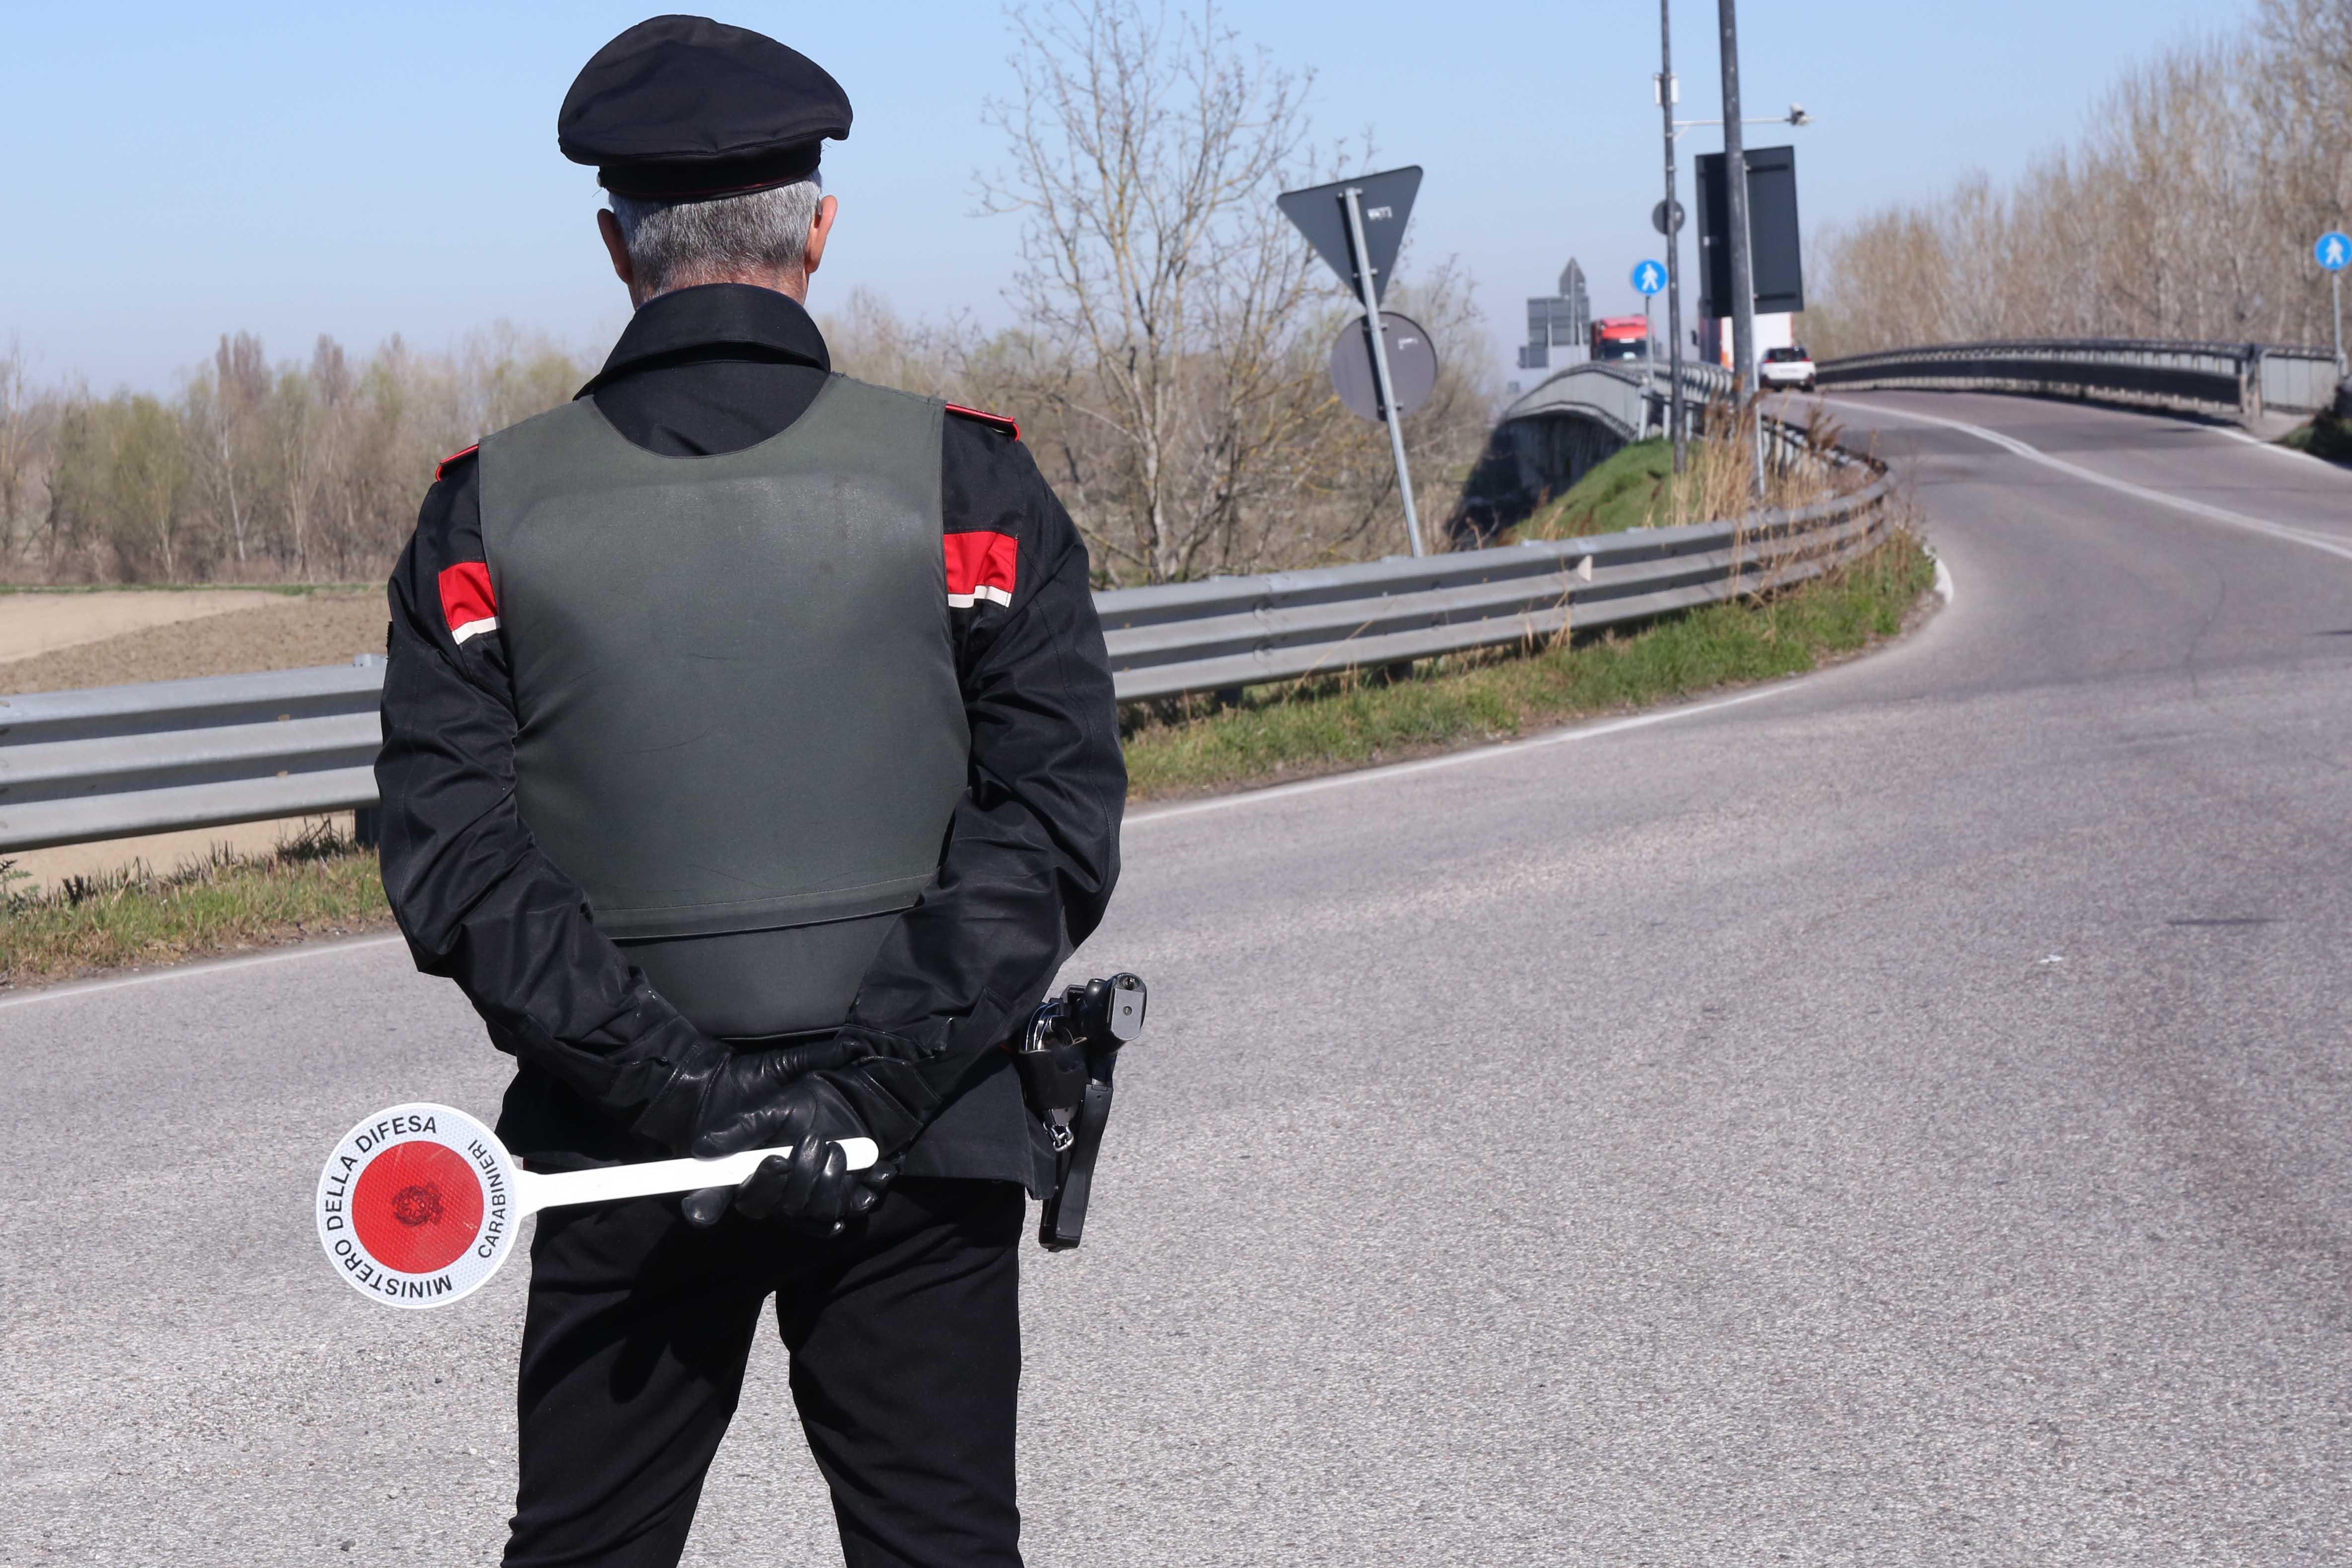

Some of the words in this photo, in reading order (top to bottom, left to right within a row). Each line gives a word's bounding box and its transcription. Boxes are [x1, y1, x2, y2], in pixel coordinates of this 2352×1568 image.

[355, 1115, 436, 1153] DIFESA
[325, 1156, 358, 1231] DELLA
[468, 1140, 506, 1258] CARABINIERI
[335, 1239, 452, 1298] MINISTERO
